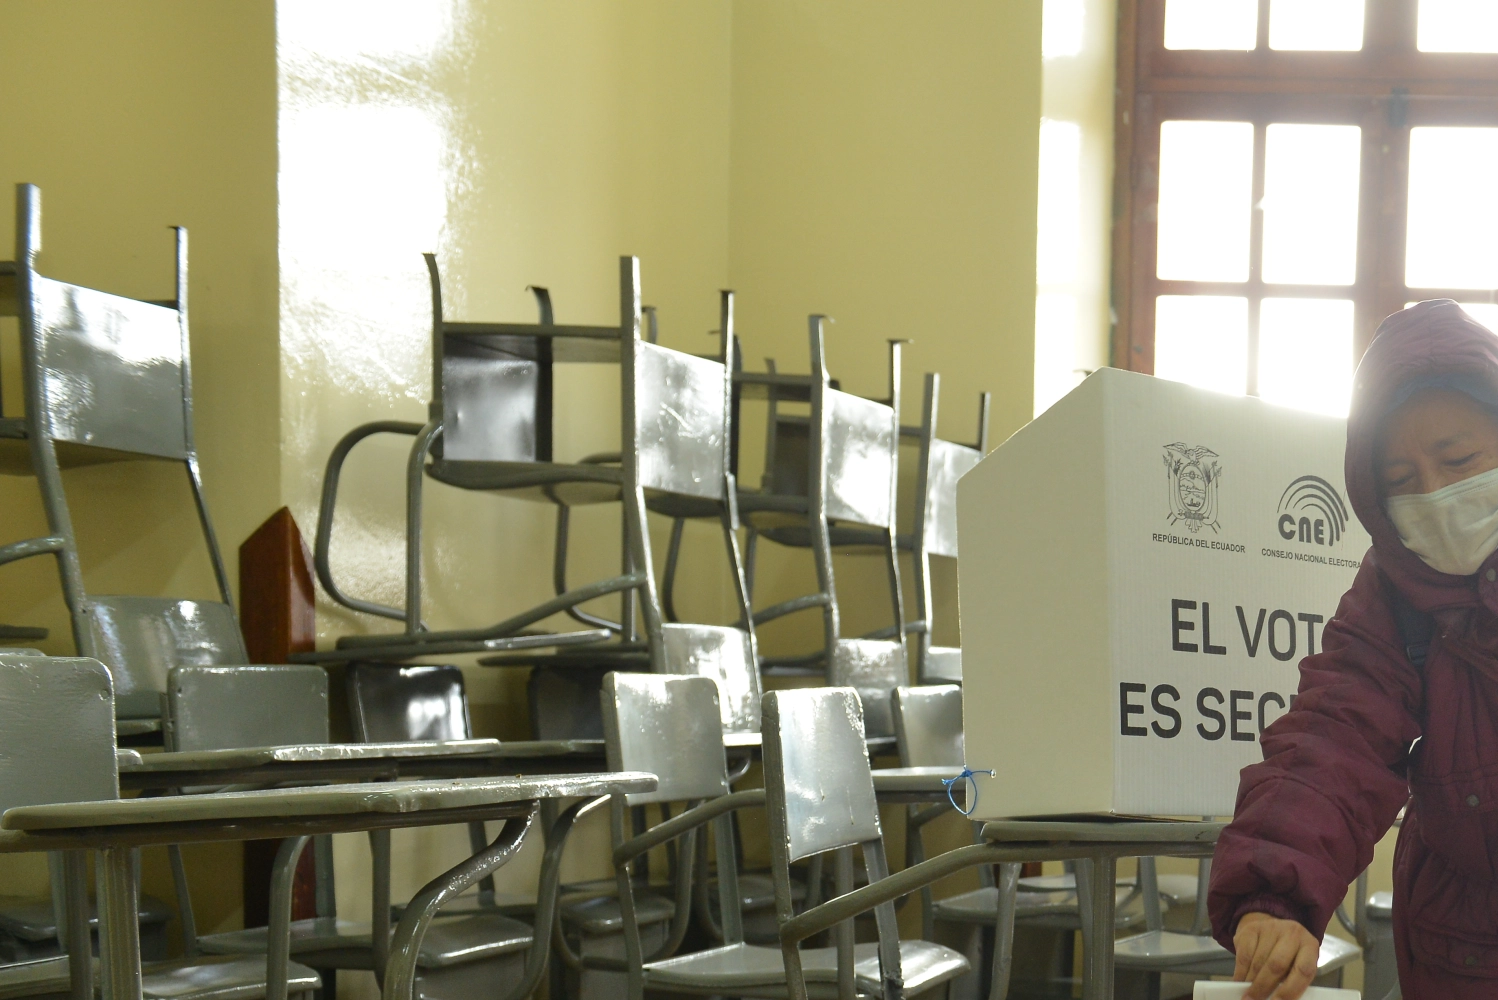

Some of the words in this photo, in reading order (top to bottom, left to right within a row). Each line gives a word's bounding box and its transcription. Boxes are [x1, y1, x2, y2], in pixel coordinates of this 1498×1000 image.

[1152, 533, 1194, 546] REPÚBLICA
[1196, 540, 1210, 548] DEL
[1211, 541, 1245, 553] ECUADOR
[1261, 548, 1293, 560] CONSEJO
[1294, 552, 1327, 564] NACIONAL
[1328, 557, 1361, 569] ELECTORA
[1171, 598, 1226, 655] EL
[1235, 605, 1324, 662] VOT
[1119, 681, 1182, 738] ES
[1196, 687, 1299, 741] SEC
